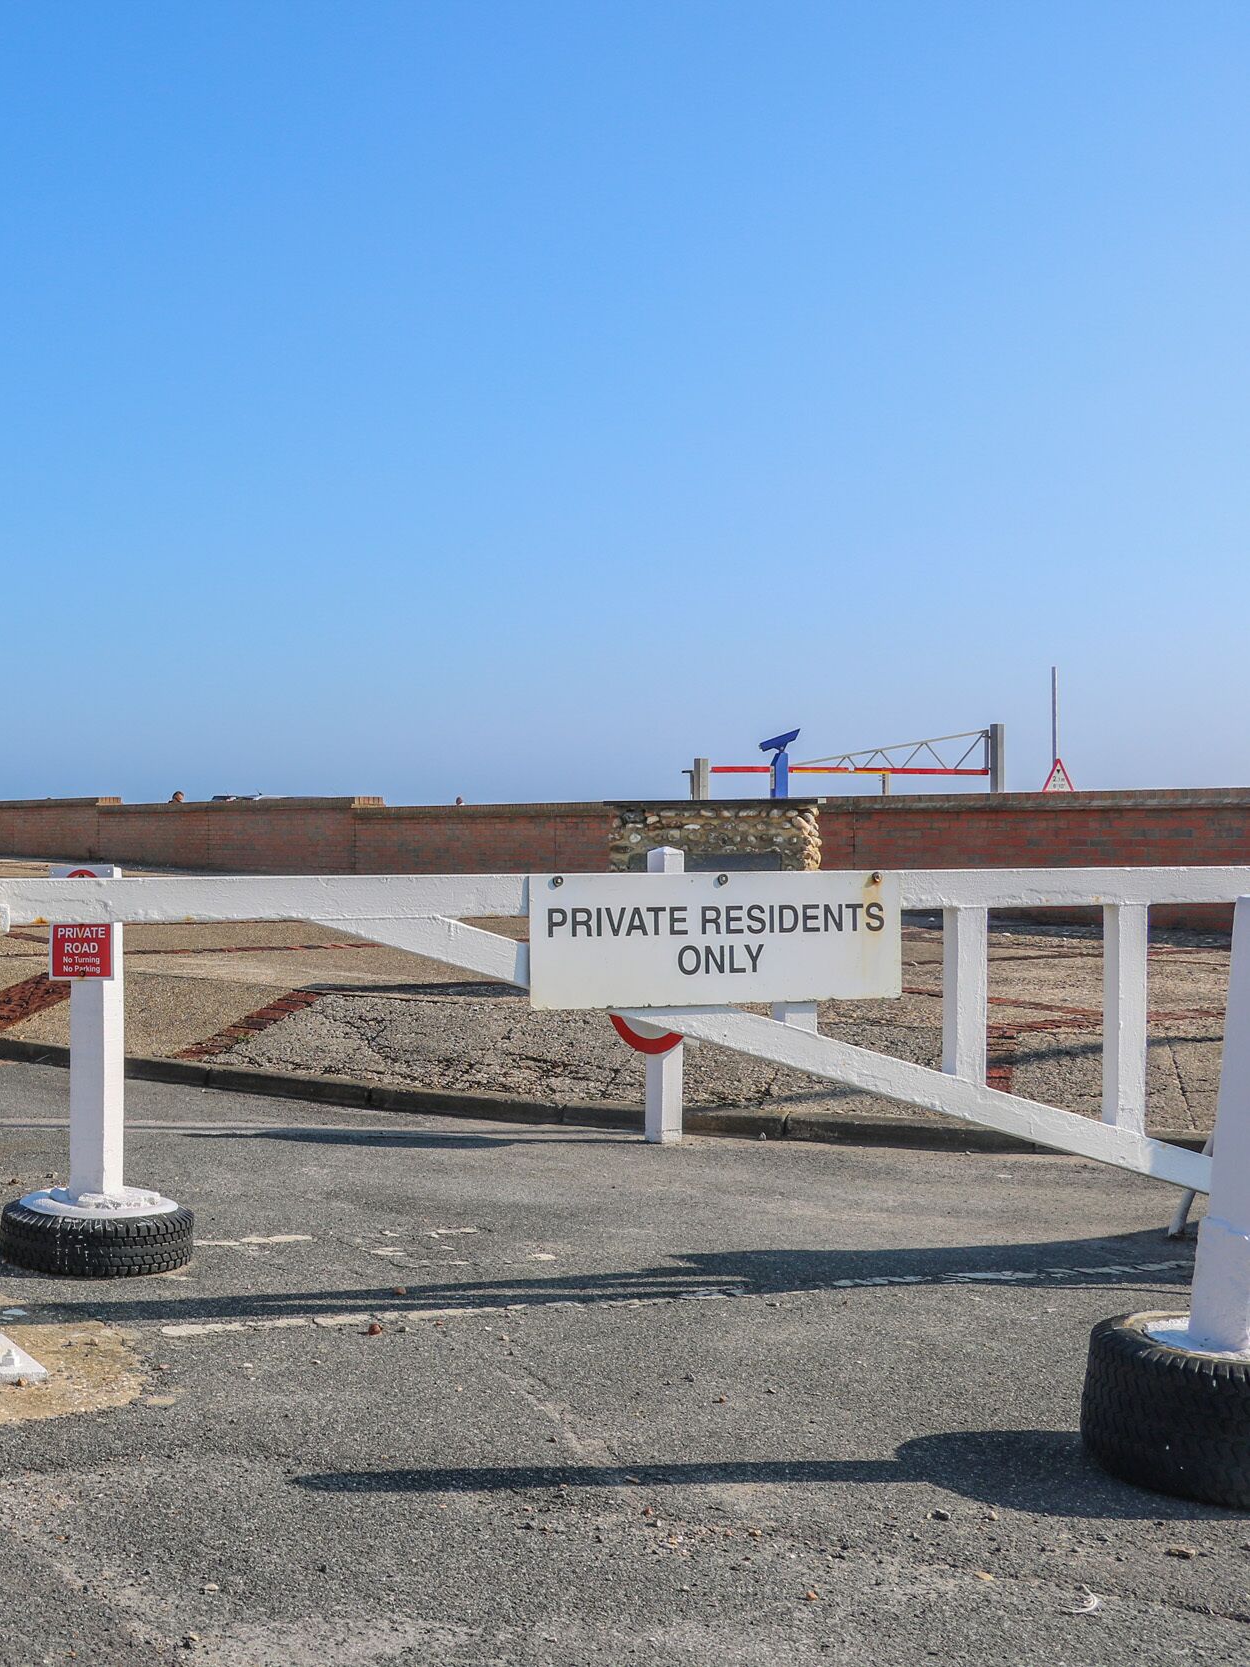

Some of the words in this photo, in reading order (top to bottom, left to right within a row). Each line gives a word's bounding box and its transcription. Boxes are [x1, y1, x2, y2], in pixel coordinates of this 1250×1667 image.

[547, 905, 689, 938] PRIVATE
[701, 901, 885, 936] RESIDENTS
[57, 927, 106, 939] PRIVATE
[64, 942, 99, 954] ROAD
[62, 956, 73, 964] No
[74, 956, 100, 965] Turning
[677, 943, 765, 976] ONLY
[62, 965, 73, 973] No
[74, 965, 101, 974] Parking
